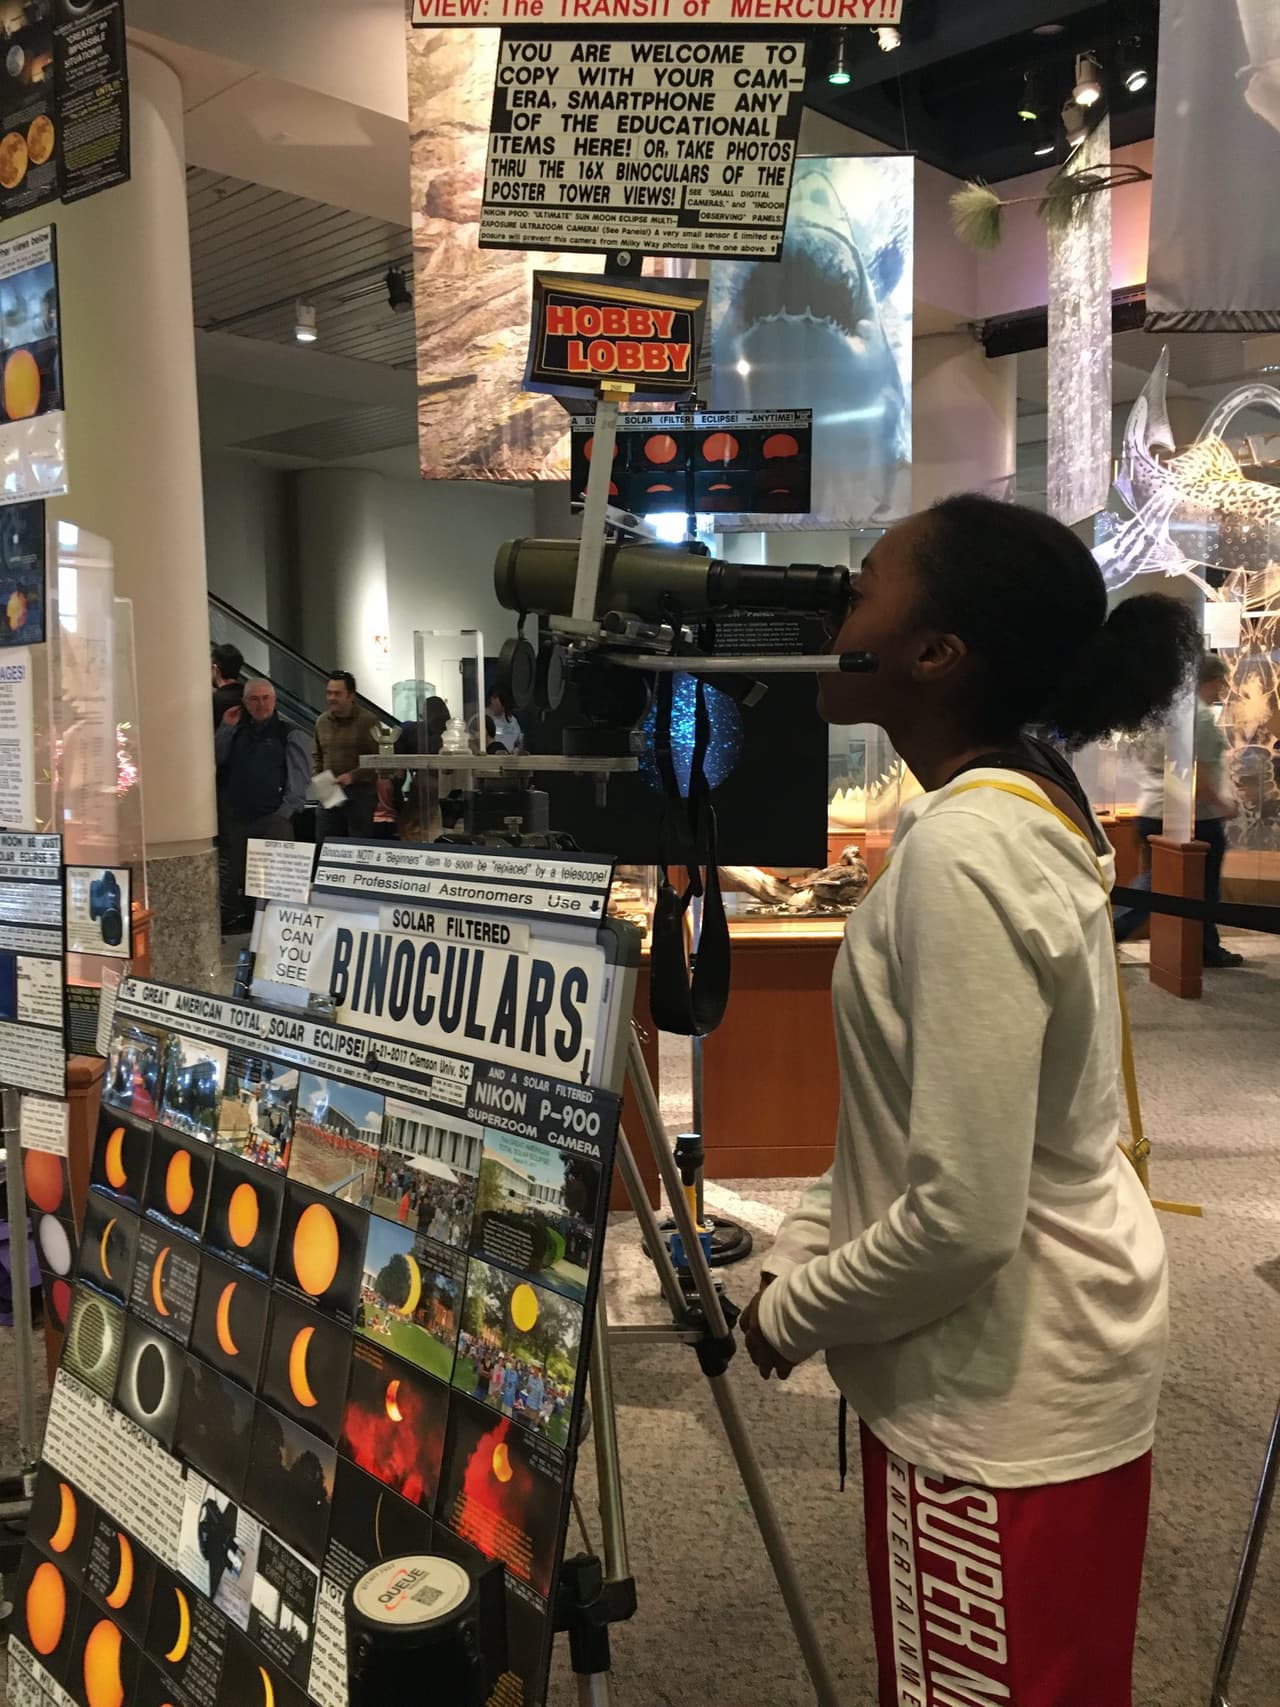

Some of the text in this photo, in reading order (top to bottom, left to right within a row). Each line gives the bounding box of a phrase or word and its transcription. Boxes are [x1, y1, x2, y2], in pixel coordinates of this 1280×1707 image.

[418, 0, 897, 18] VIEW: The TRANSIT of MERCURY!!
[508, 43, 797, 64] YOU ARE WELCOME TO
[500, 66, 559, 85] COPY
[578, 67, 634, 86] WITH
[654, 68, 714, 88] YOUR
[512, 90, 783, 113] ERA, SMARTPHONE ANY
[513, 114, 770, 137] OF THE EDUCATIONAL
[493, 136, 631, 157] ITEMS HERE!
[644, 138, 791, 162] OR, TAKE PHOTOS
[491, 158, 786, 186] THRU THE 16X BINOCULARS OF THE
[491, 182, 676, 206] POSTER TOWER VIEWS!
[689, 188, 770, 198] SEE "SMALL DIGITAL
[483, 209, 506, 218] NIKON
[533, 211, 572, 220] "ULTIMATE"
[575, 213, 590, 221] SUN
[592, 214, 616, 222] MOON
[618, 215, 648, 223] ECLIPSE
[700, 212, 747, 221] OBSERVING"
[752, 201, 785, 209] "INDOOR
[481, 220, 517, 229] EXPOSURE
[520, 222, 563, 231] ULTRAZOOM
[566, 224, 600, 233] CAMERA!
[602, 226, 619, 235] (See
[622, 227, 651, 237] Panels!)
[663, 230, 679, 239] very
[682, 230, 702, 238] small
[705, 231, 730, 239] sensor
[741, 232, 767, 241] limited
[481, 232, 766, 252] posure will prevent this camera from Milky Way photos like the one above.
[546, 305, 676, 339] HOBBY
[567, 340, 691, 373] LOBBY
[625, 416, 653, 425] SOLAR
[660, 415, 694, 425] (FILTER)
[702, 414, 739, 424] ECLIPSE!
[385, 852, 423, 866] "Beginners"
[444, 857, 451, 868] to
[455, 860, 473, 870] soon
[477, 860, 487, 871] be
[492, 860, 532, 876] "replaced"
[536, 864, 546, 879] by
[551, 867, 556, 878] a
[561, 866, 608, 884] telescope!
[317, 870, 581, 911] Even Professional Astronomers Use
[278, 909, 324, 929] WHAT
[392, 909, 510, 945] SOLAR FILTERED
[281, 928, 314, 946] CAN
[279, 945, 311, 964] YOU
[275, 963, 308, 982] SEE
[329, 927, 588, 1063] BINOCULARS
[142, 986, 170, 1005] GREAT
[175, 994, 222, 1021] AMERICAN
[230, 1008, 261, 1031] TOTAL
[269, 1017, 304, 1043] SOLAR
[313, 1029, 365, 1059] ECLIPSE!
[409, 1052, 438, 1071] Clemson
[440, 1059, 456, 1077] Univ.
[459, 1064, 470, 1080] SC
[488, 1067, 593, 1103] AND A SOLAR FILTERED
[475, 1081, 527, 1117] NIKON
[539, 1099, 601, 1137] P-900
[467, 1107, 538, 1138] SUPERZOOM
[548, 1131, 601, 1158] CAMERA
[915, 1463, 1008, 1665] SUPER
[325, 1579, 345, 1607] TOT
[378, 1568, 425, 1604] QUEUE
